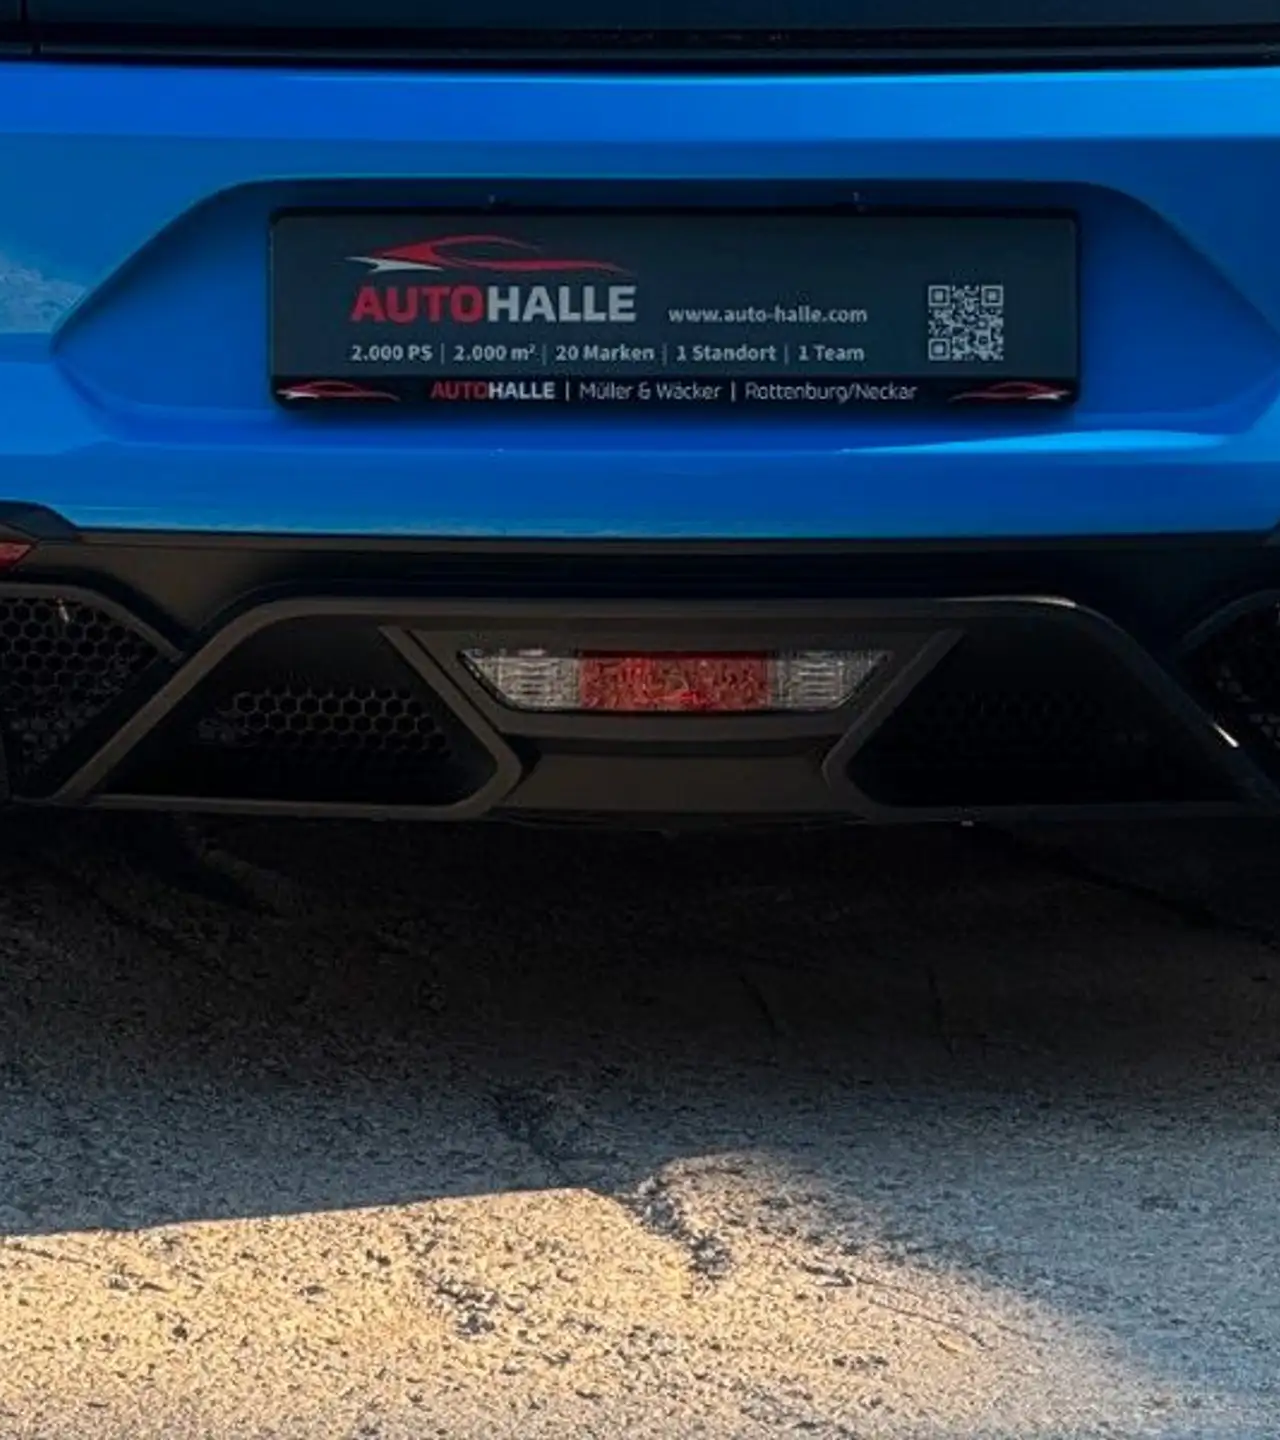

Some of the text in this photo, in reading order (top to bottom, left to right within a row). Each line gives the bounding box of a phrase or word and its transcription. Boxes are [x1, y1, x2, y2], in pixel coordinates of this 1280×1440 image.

[350, 284, 638, 323] AUTOHALLE
[668, 305, 868, 324] www.auto-halle.com
[351, 344, 403, 362] 2.000
[408, 344, 434, 362] PS
[453, 344, 507, 362] 2.000
[555, 344, 579, 362] 20
[582, 342, 656, 362] Marken
[676, 344, 686, 362] 1
[692, 343, 777, 362] Standort
[798, 344, 808, 362] 1
[816, 344, 866, 362] Team
[431, 381, 556, 401] AUTOHALLE
[579, 380, 634, 401] Müller
[638, 382, 651, 401] &
